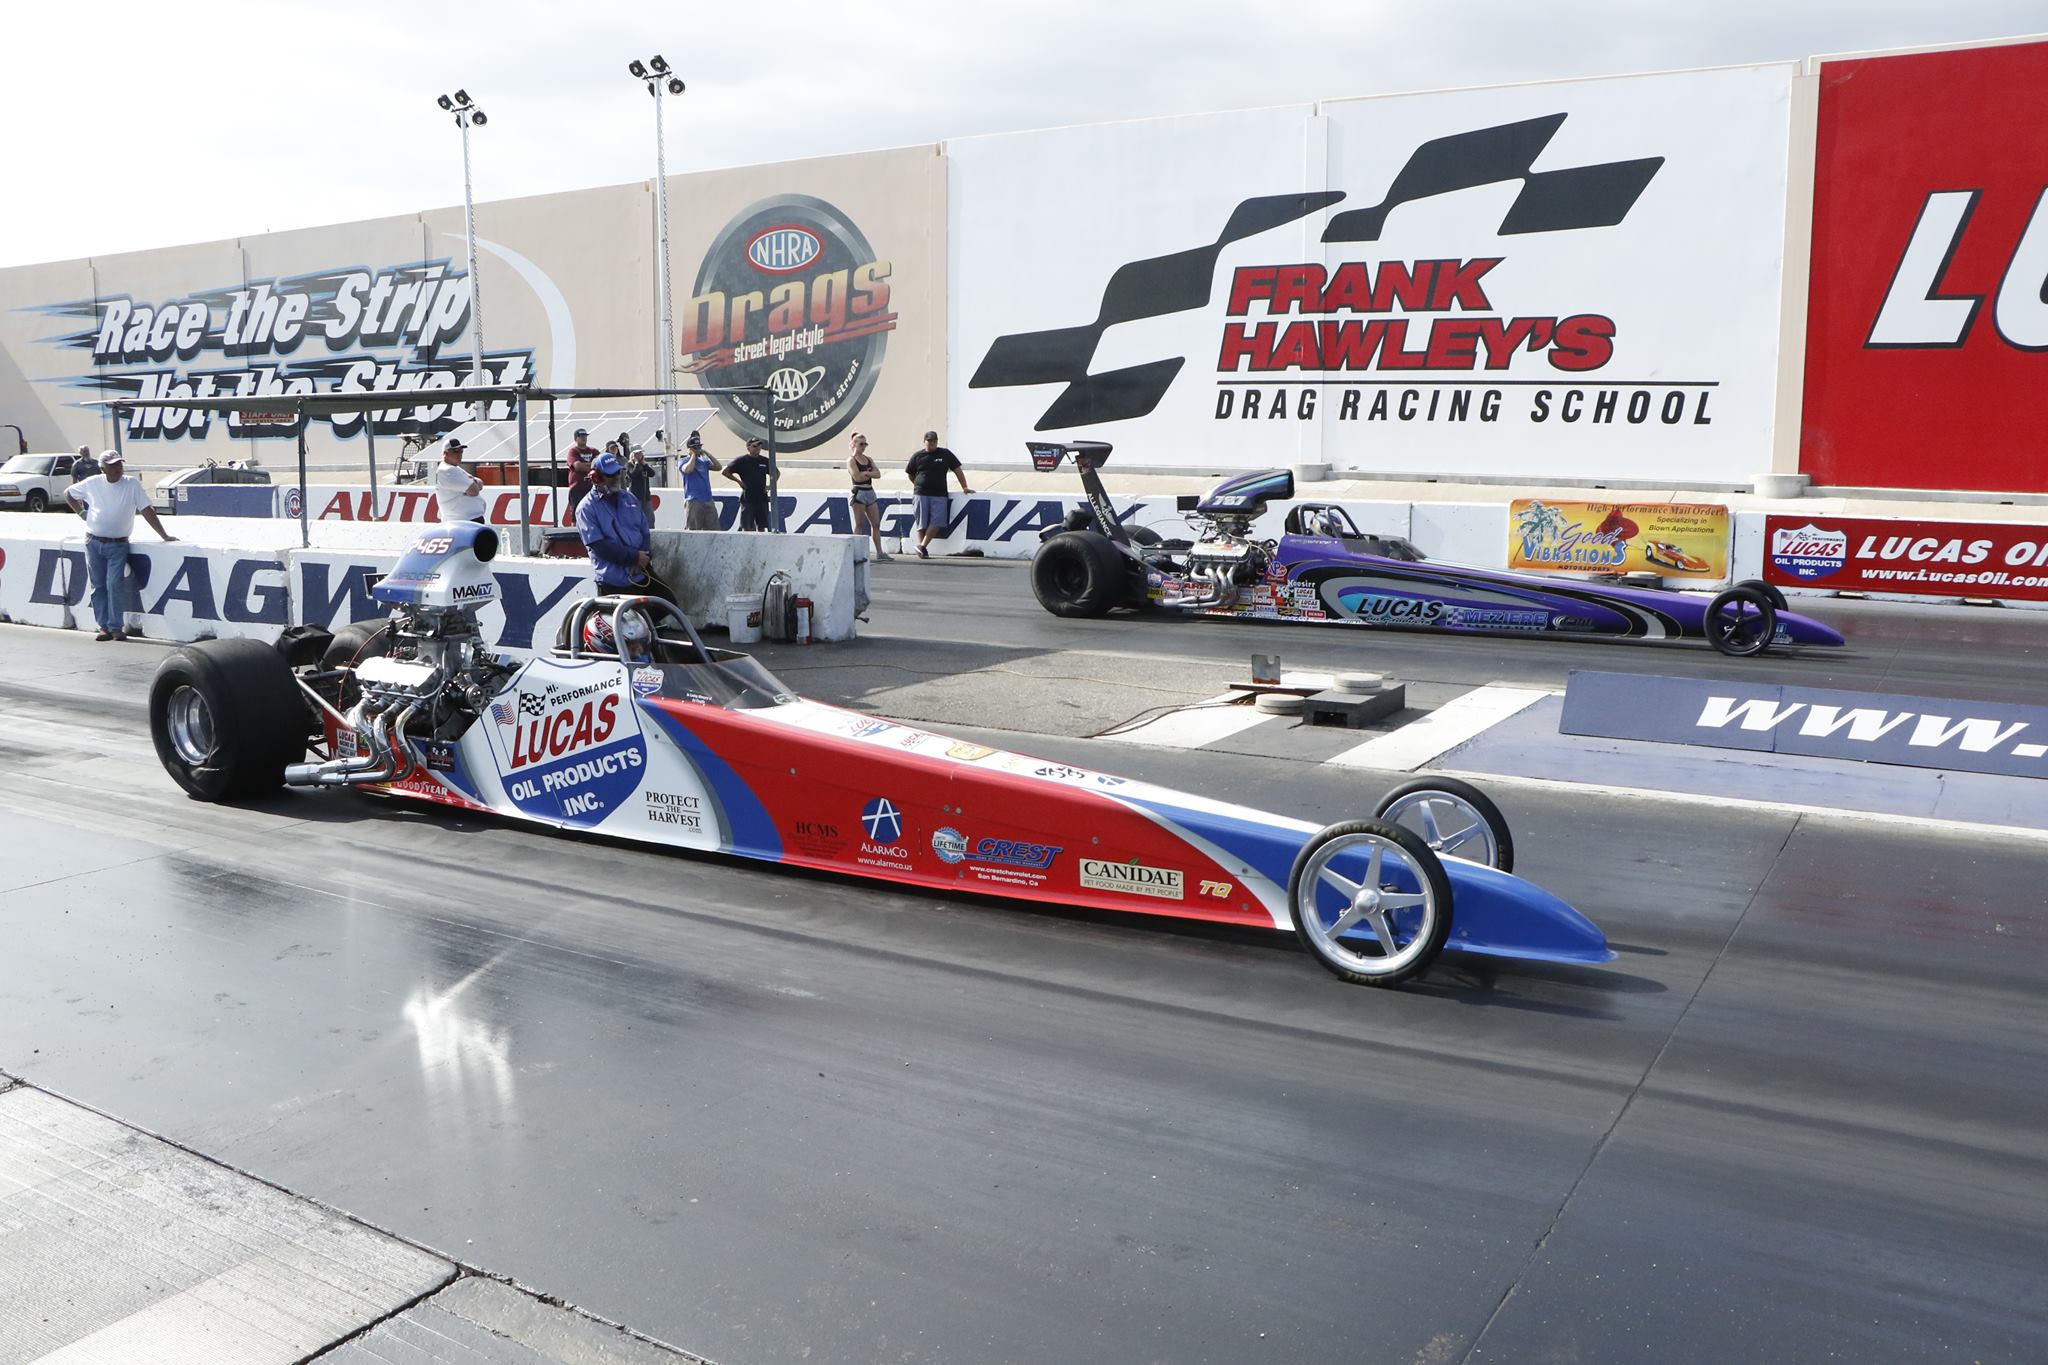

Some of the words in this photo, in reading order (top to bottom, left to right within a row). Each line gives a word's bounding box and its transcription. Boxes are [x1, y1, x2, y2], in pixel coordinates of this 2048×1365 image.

[756, 232, 814, 266] NHRA
[1226, 257, 1506, 316] FRANK
[94, 298, 208, 356] Race
[223, 283, 302, 346] the
[326, 265, 471, 347] Strip
[681, 260, 892, 355] Drags
[734, 340, 768, 364] street
[769, 329, 795, 361] legal
[796, 323, 825, 354] style
[1217, 314, 1617, 372] HAWLEY'S
[129, 372, 216, 430] Not
[330, 355, 528, 426] Street
[731, 392, 750, 412] ace
[749, 408, 766, 423] the
[773, 416, 794, 429] trip
[801, 409, 819, 423] not
[820, 396, 837, 414] the
[835, 358, 860, 399] street
[771, 369, 801, 400] AAA
[1214, 389, 1316, 421] DRAG
[1339, 389, 1502, 423] RACING
[1530, 390, 1715, 426] SCHOOL
[1087, 493, 1113, 538] ALLEGIANCE
[1656, 516, 1699, 525] Specializing
[1669, 507, 1692, 515] Mail
[1692, 508, 1725, 517] Order!
[1560, 522, 1624, 554] Good
[1648, 524, 1670, 532] Blown
[1671, 525, 1715, 534] Applications
[1522, 533, 1627, 566] VIBRATIONS
[1779, 540, 1843, 557] LUCAS
[1855, 535, 1993, 564] LUCAS
[1774, 557, 1791, 565] OIL
[1792, 558, 1843, 568] PRODUCTS
[1798, 568, 1818, 576] INC.
[29, 547, 587, 649] DRAGWY
[1356, 598, 1443, 618] LUCAS
[1464, 609, 1547, 625] MEZIERE
[550, 677, 622, 707] PERFORMANCE
[339, 730, 355, 741] LUCAS
[510, 692, 620, 769] LUCAS
[511, 779, 541, 802] OIL
[542, 747, 643, 793] PRODUCTS
[396, 781, 448, 797] GOODYEAR
[646, 791, 700, 809] PROTECT
[563, 791, 605, 817] INC.
[665, 804, 682, 814] THE
[648, 810, 701, 827] HARVEST
[795, 820, 839, 838] HCMS
[933, 840, 966, 851] LIFETIME
[977, 837, 1064, 868] CREST
[857, 856, 913, 872] www.alarmco.us
[969, 865, 1047, 880] www.crestchevrolet.com
[1084, 861, 1179, 887] CANIDAE
[991, 874, 1028, 885] Bernardino,
[1096, 880, 1115, 889] FOOD
[1116, 884, 1134, 892] MADE
[1144, 887, 1156, 895] PET
[1156, 888, 1180, 898] PEOPLE
